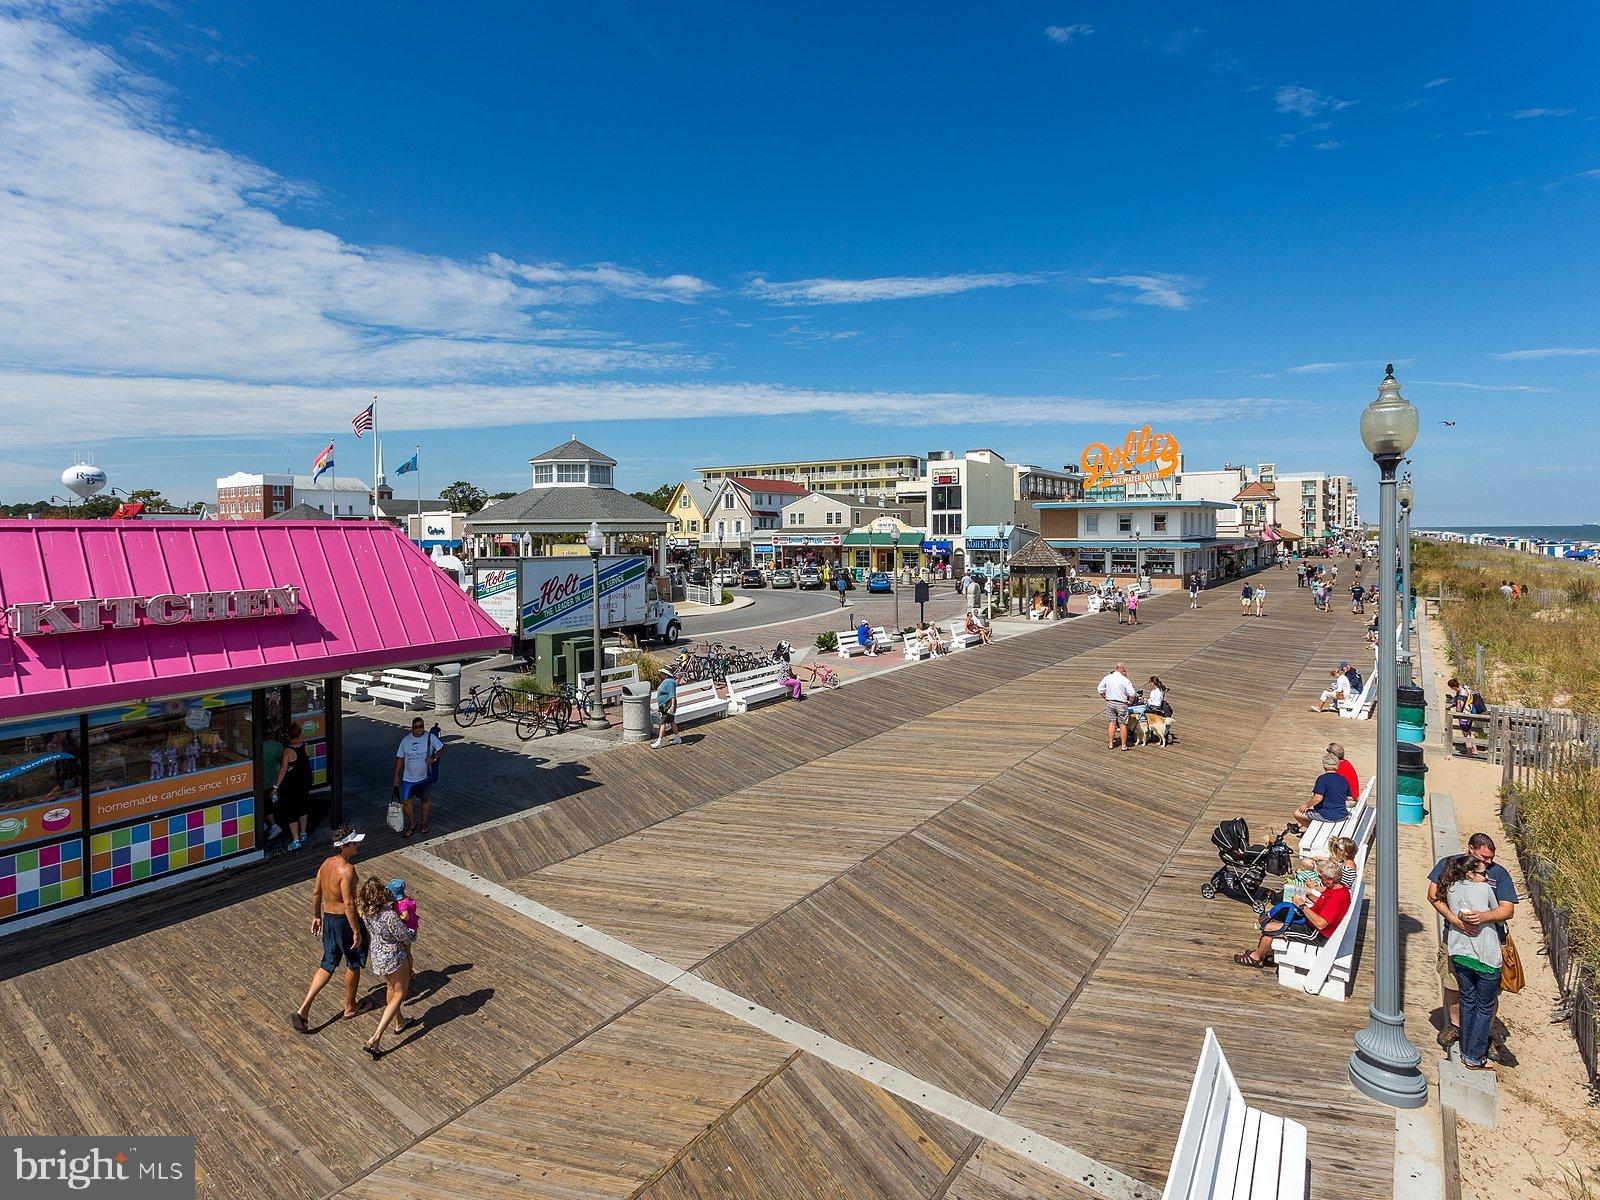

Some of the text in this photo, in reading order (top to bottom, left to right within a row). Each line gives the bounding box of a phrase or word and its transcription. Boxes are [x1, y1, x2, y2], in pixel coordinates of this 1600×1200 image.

[1110, 471, 1160, 485] SALT WATER TAFFY
[966, 540, 985, 548] KOHR
[481, 570, 506, 590] Holt
[531, 573, 579, 615] Holt
[543, 606, 555, 618] THE
[555, 598, 575, 613] LEADER
[575, 594, 581, 603] IN
[606, 574, 624, 588] SERVICE
[9, 584, 300, 637] KITCHEN
[97, 772, 248, 815] homemade candies since 1937
